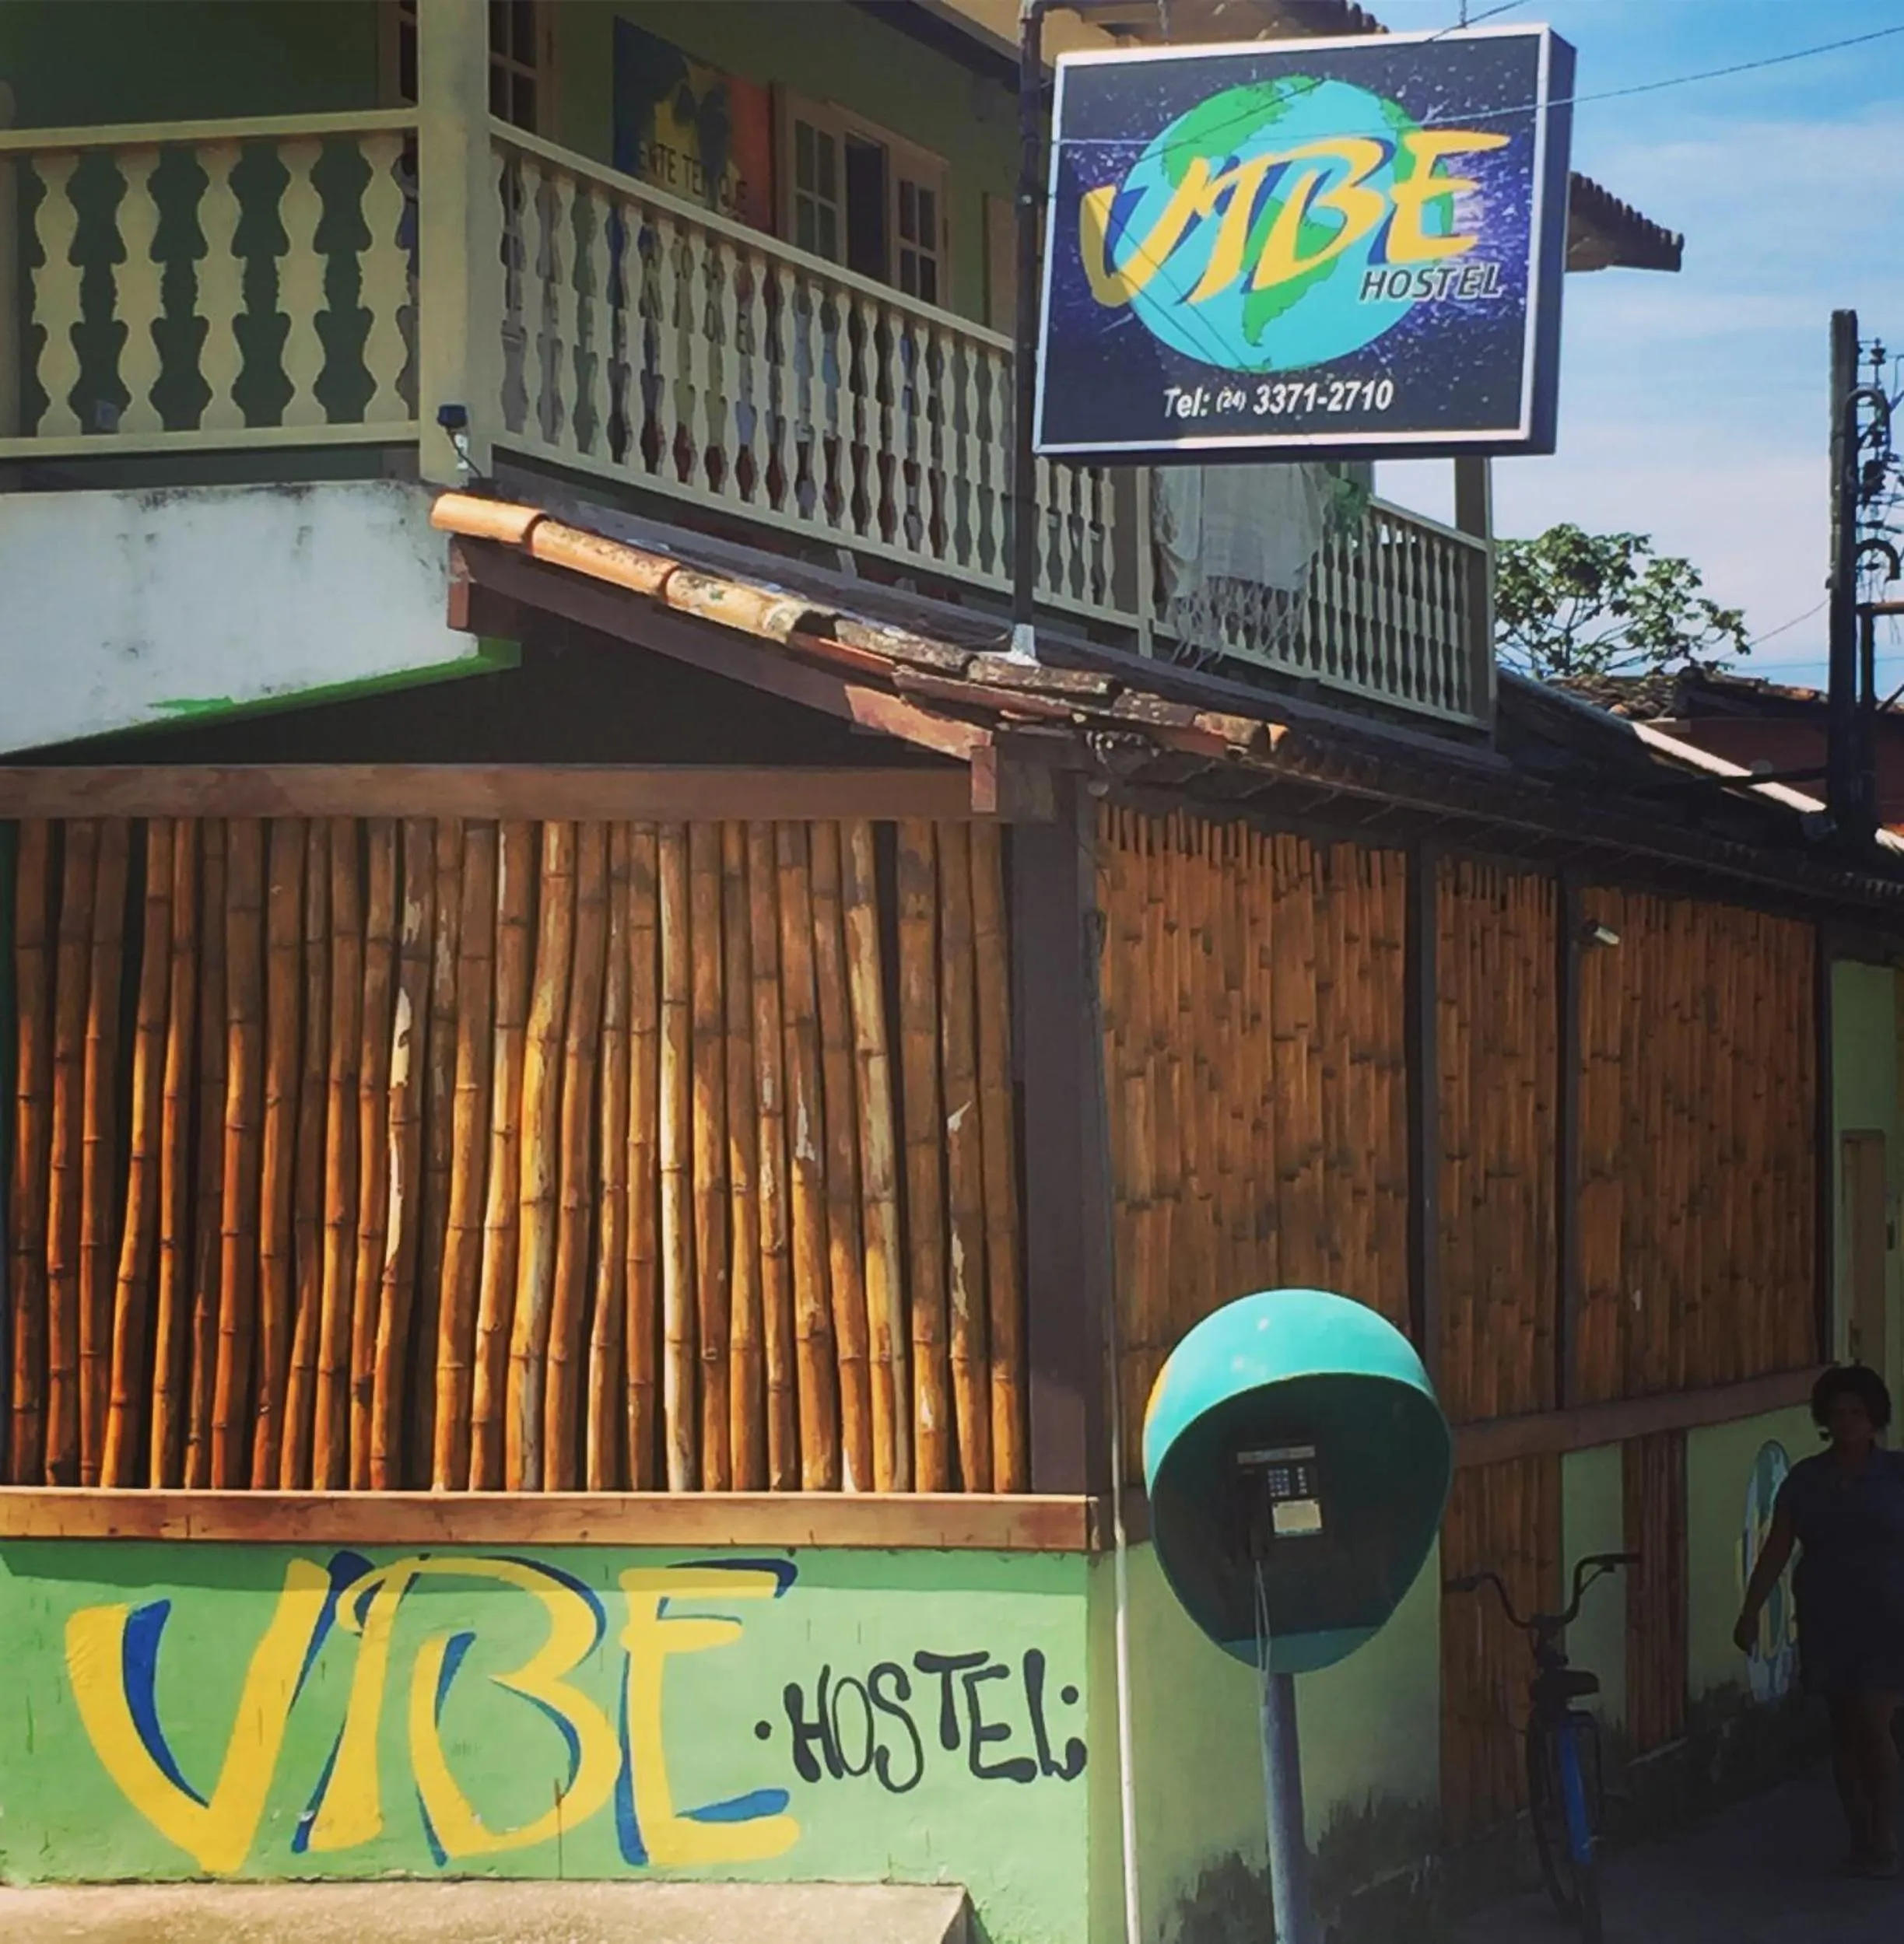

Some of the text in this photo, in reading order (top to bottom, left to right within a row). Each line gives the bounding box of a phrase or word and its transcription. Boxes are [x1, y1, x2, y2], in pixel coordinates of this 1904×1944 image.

[1080, 128, 1511, 308] VIBE
[1359, 263, 1504, 305] HOSTEL
[1163, 379, 1394, 418] Tel: (24) 3371-2710
[65, 1550, 800, 1872] VIBE
